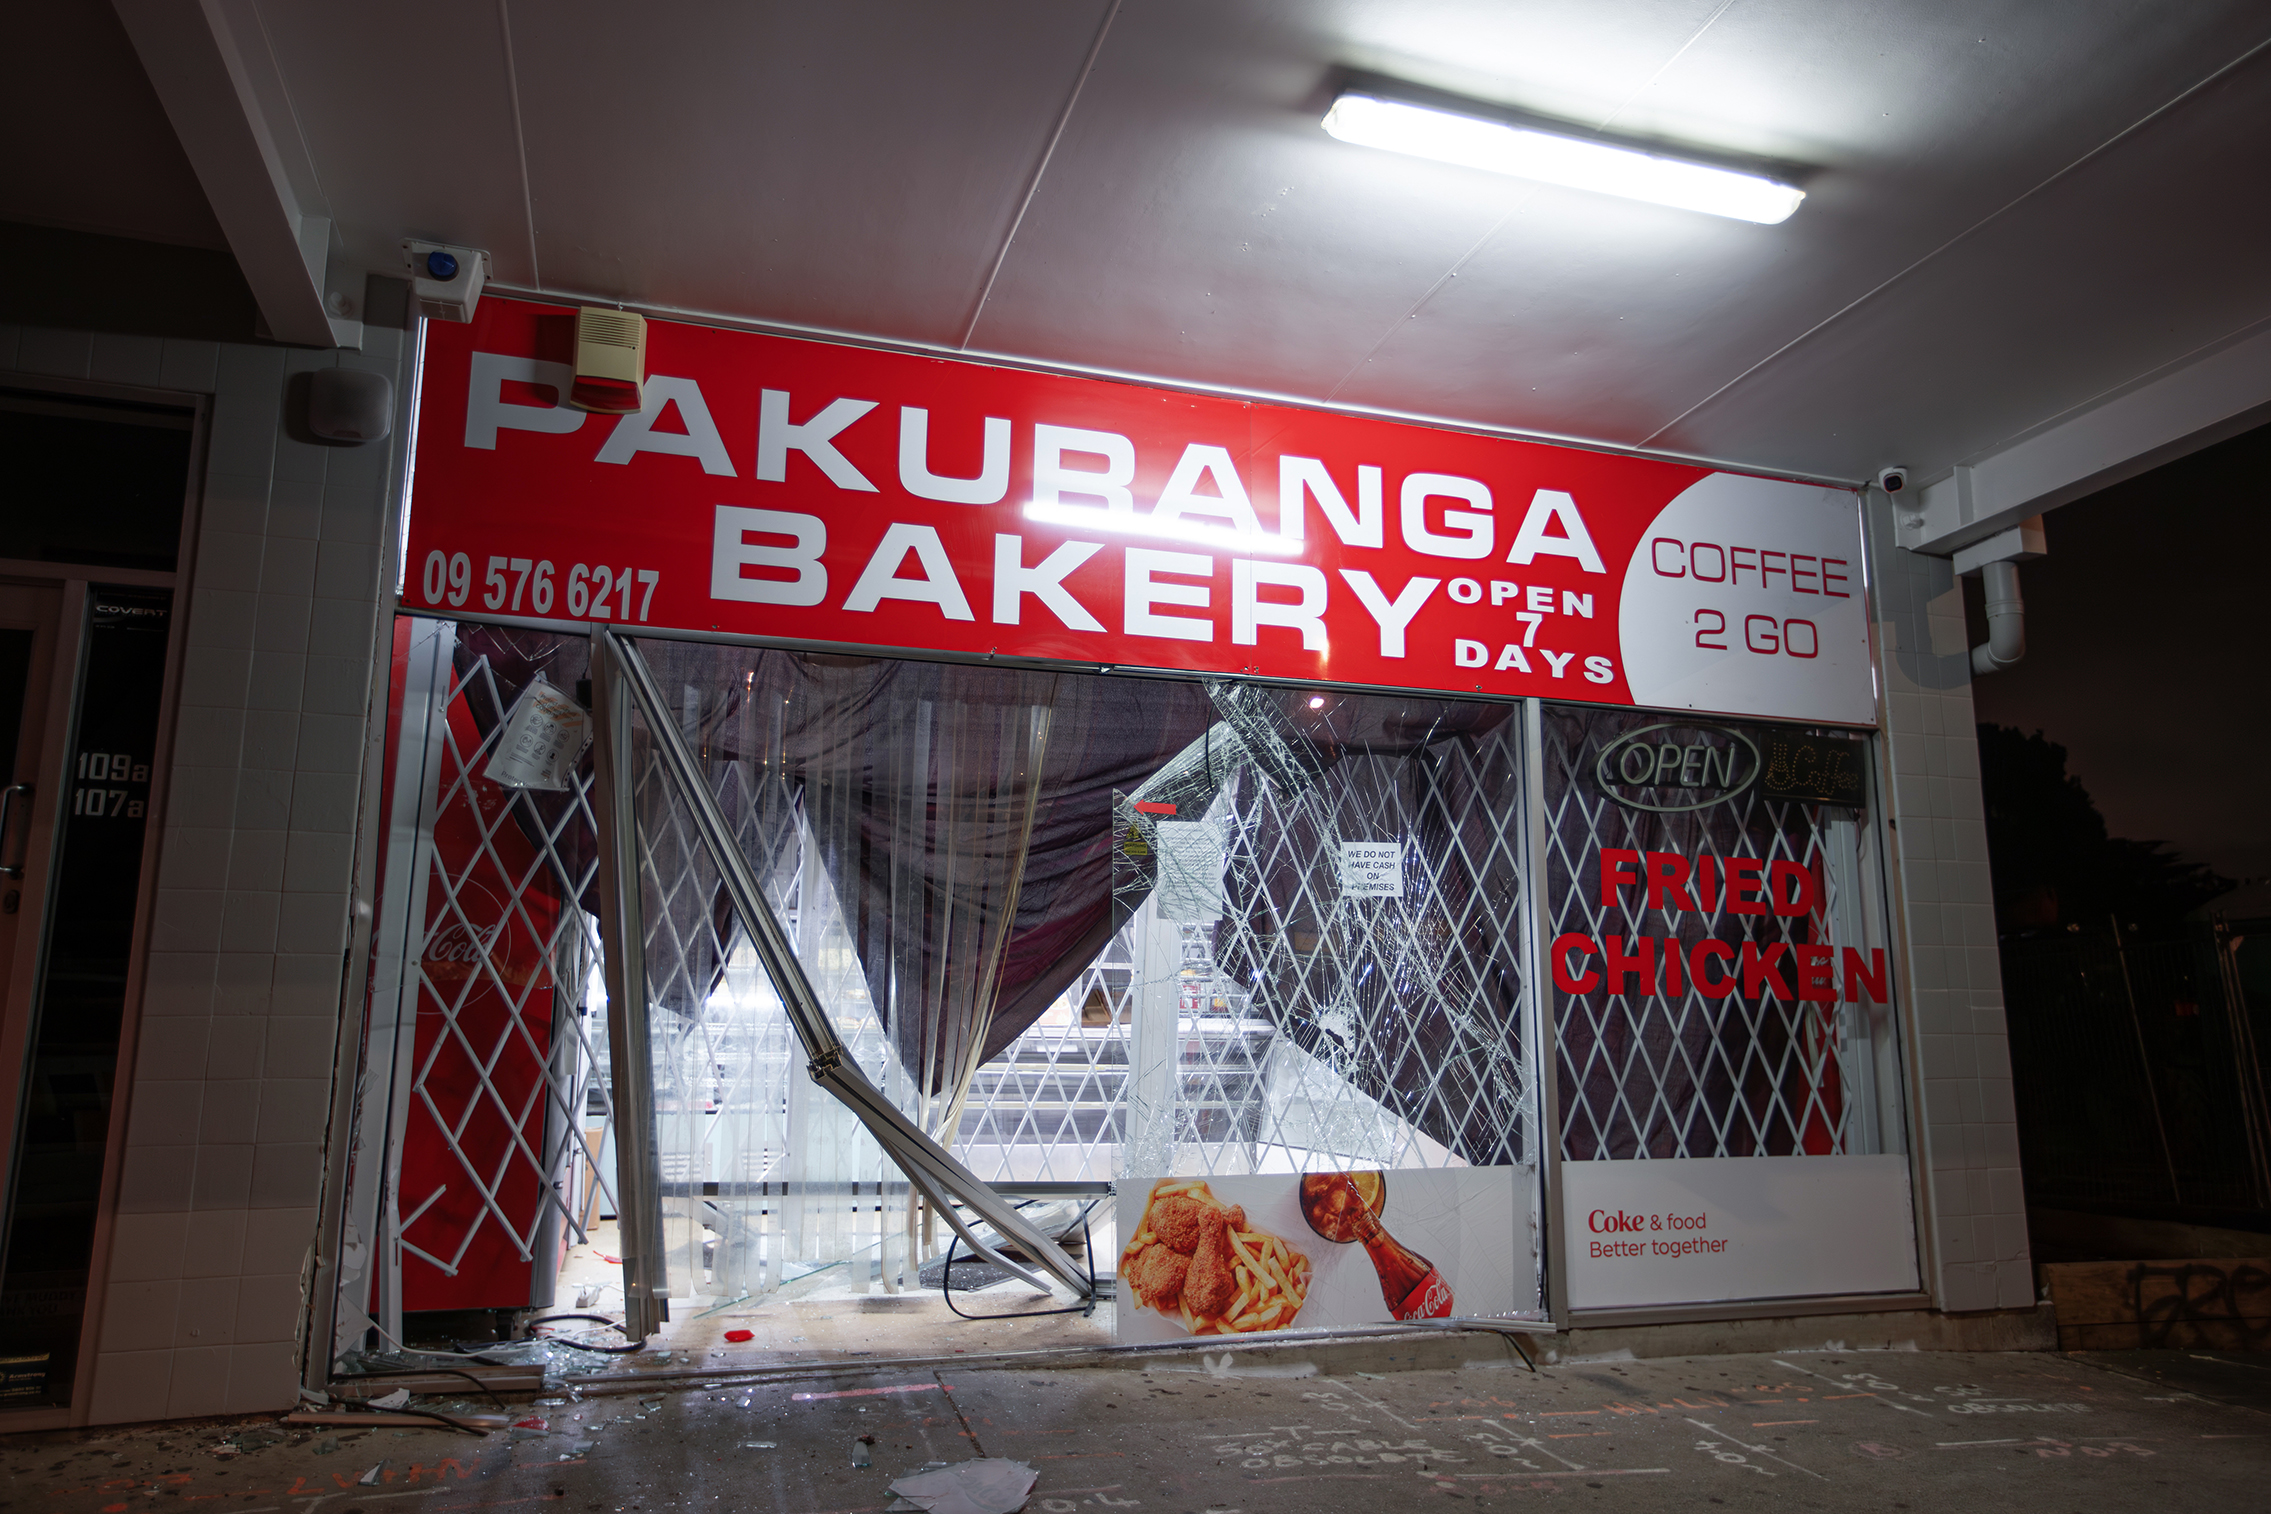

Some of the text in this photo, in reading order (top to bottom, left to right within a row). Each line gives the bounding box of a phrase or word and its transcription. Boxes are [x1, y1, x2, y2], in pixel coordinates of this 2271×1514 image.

[464, 350, 1606, 574] PAKURANGA
[422, 549, 660, 622] 09 576 6217
[710, 504, 1441, 658] BAKERY
[1651, 537, 1851, 598] COFFEE
[96, 605, 168, 617] COVERT
[1447, 577, 1594, 618] OPEN
[1516, 612, 1544, 647] 7
[1694, 608, 1819, 659] 2 GO
[1454, 639, 1614, 684] DAYS
[78, 752, 149, 783] 109a
[1619, 742, 1736, 787] OPEN
[75, 788, 145, 818] 107a
[1348, 850, 1395, 859] WE DO NOT
[1348, 861, 1395, 869] HAVE CASH
[1366, 872, 1379, 880] ON
[1600, 847, 1815, 917] FRIED
[1551, 932, 1888, 1004] CHICKEN
[1588, 1208, 1706, 1233] Coke & food
[1589, 1236, 1728, 1258] Better together
